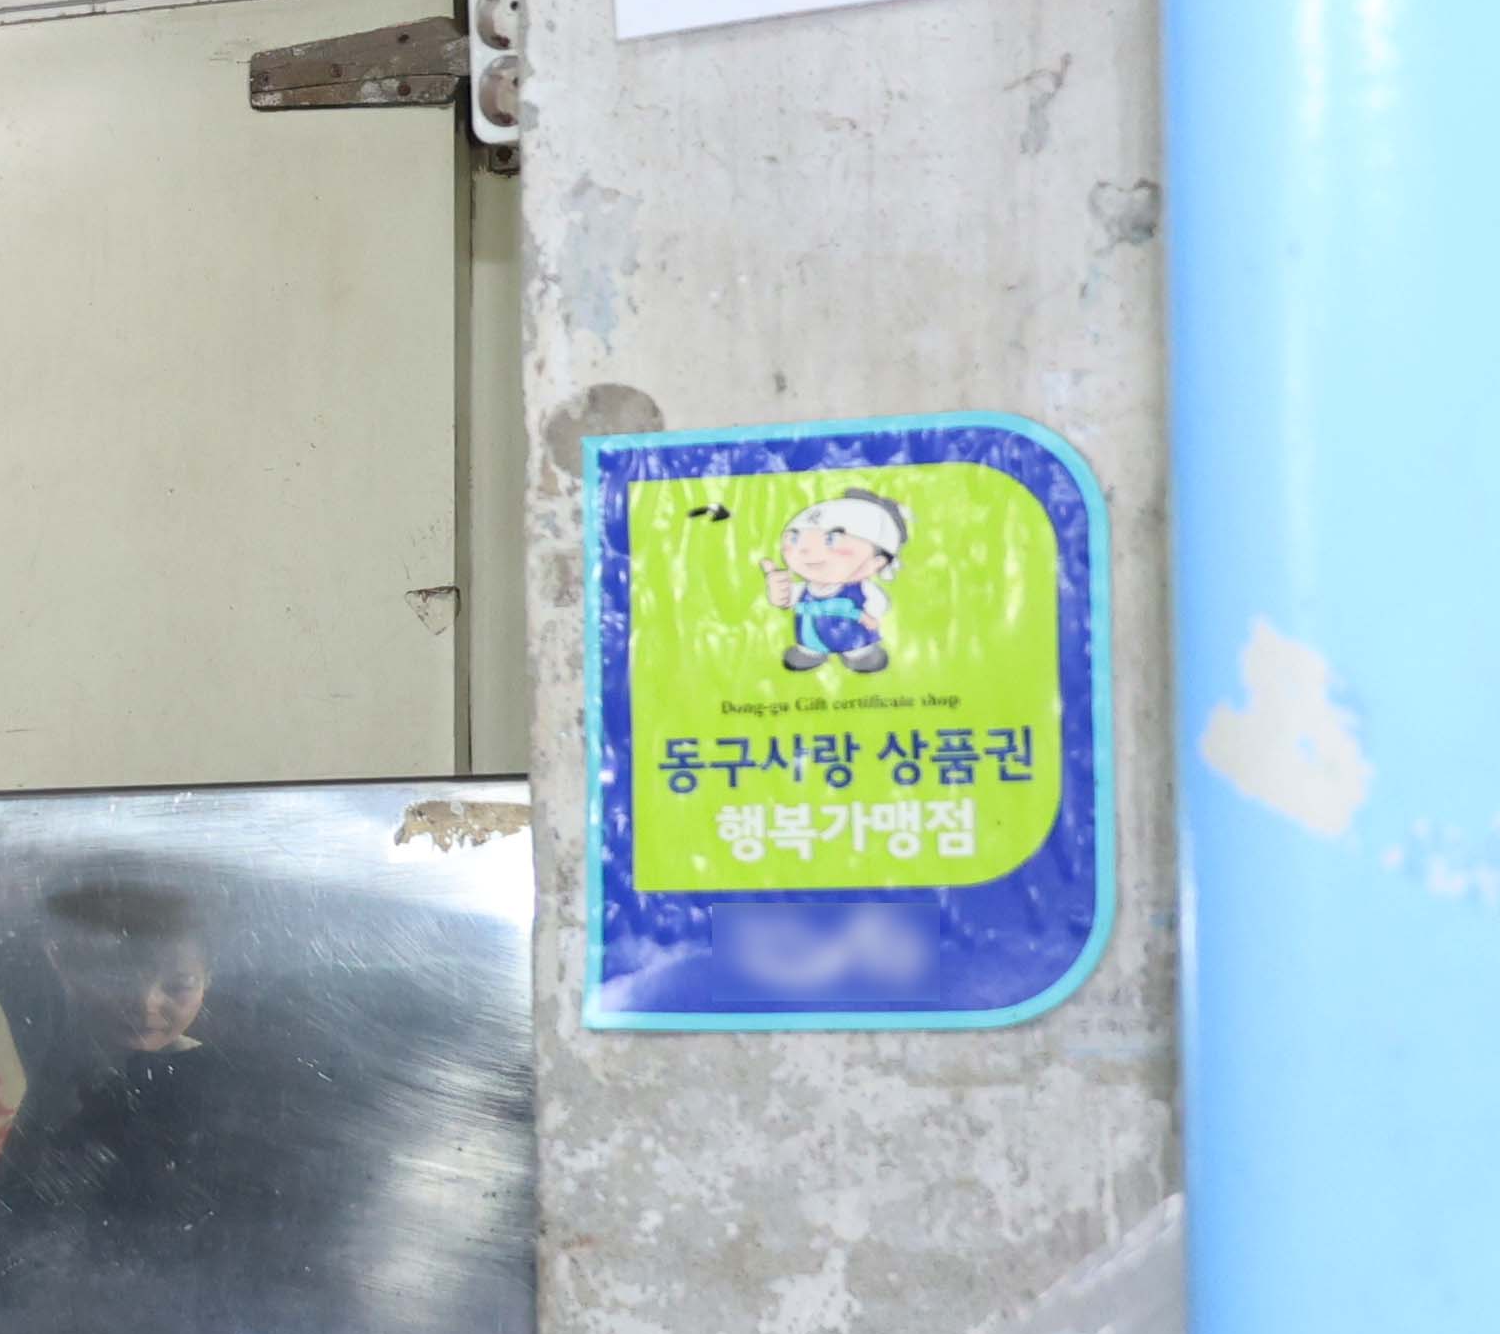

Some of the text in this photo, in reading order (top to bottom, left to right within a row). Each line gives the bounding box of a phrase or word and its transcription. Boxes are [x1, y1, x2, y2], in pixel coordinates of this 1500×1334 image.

[721, 693, 960, 718] Dong-gu Gift certificate shop
[658, 725, 1035, 795] 동구사랑 상품권
[715, 798, 977, 862] 행복가맹점
